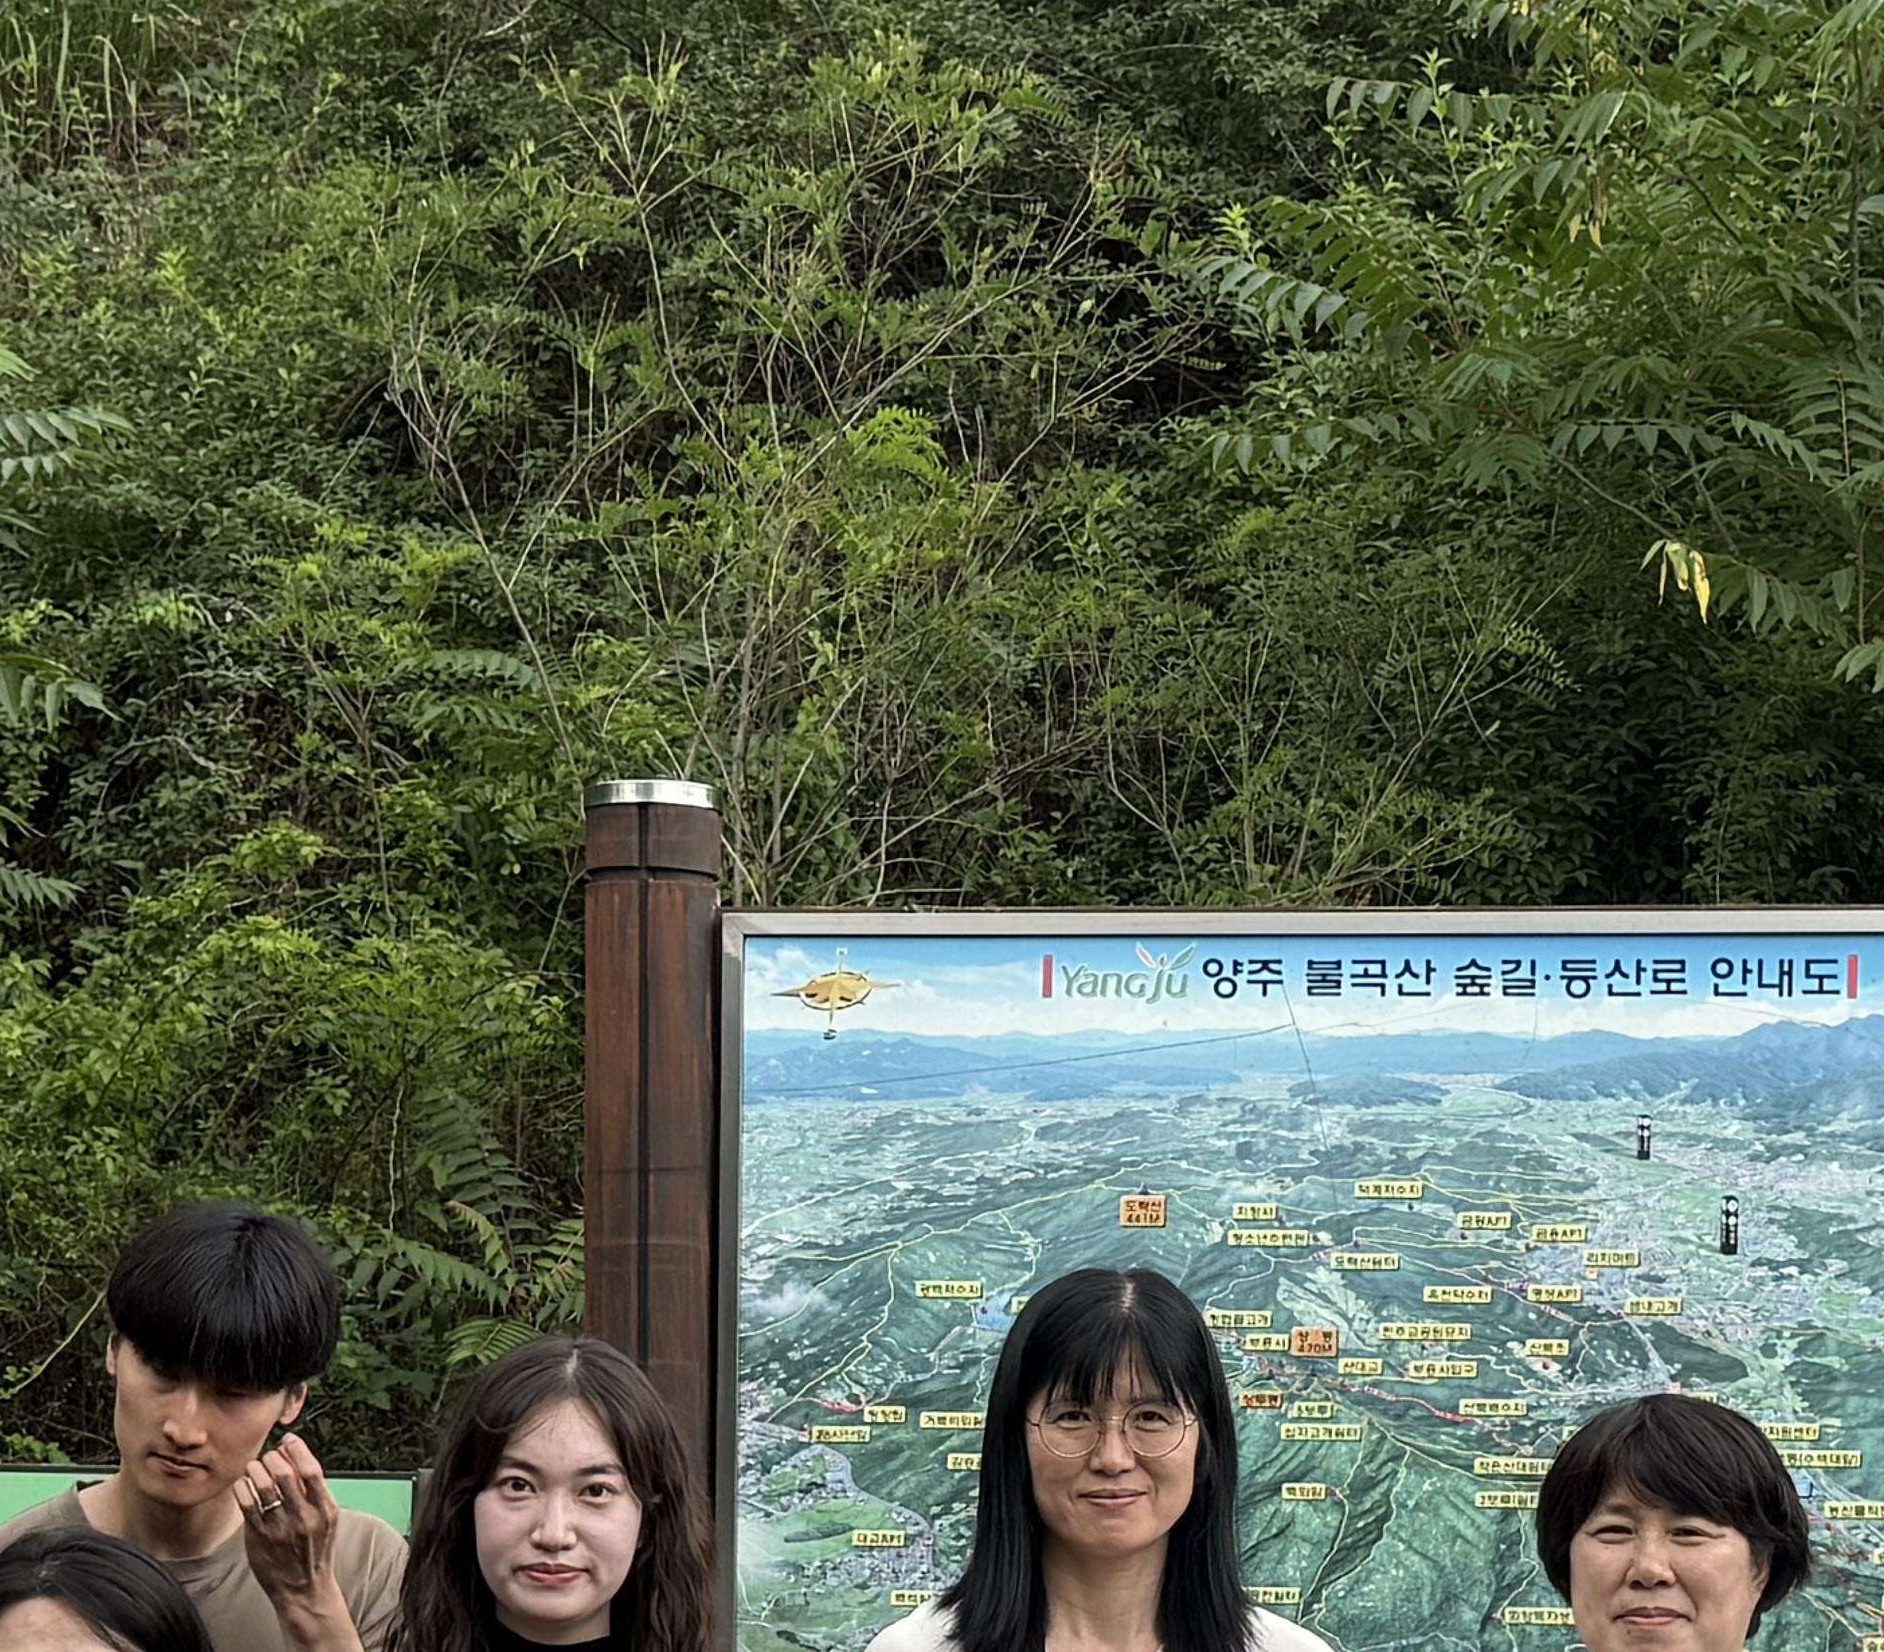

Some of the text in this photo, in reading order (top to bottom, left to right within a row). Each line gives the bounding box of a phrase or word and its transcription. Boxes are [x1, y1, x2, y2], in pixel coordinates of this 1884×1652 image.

[1204, 960, 1284, 999] 양주
[1307, 960, 1437, 997] 불곡산
[1712, 959, 1841, 998] 안내도
